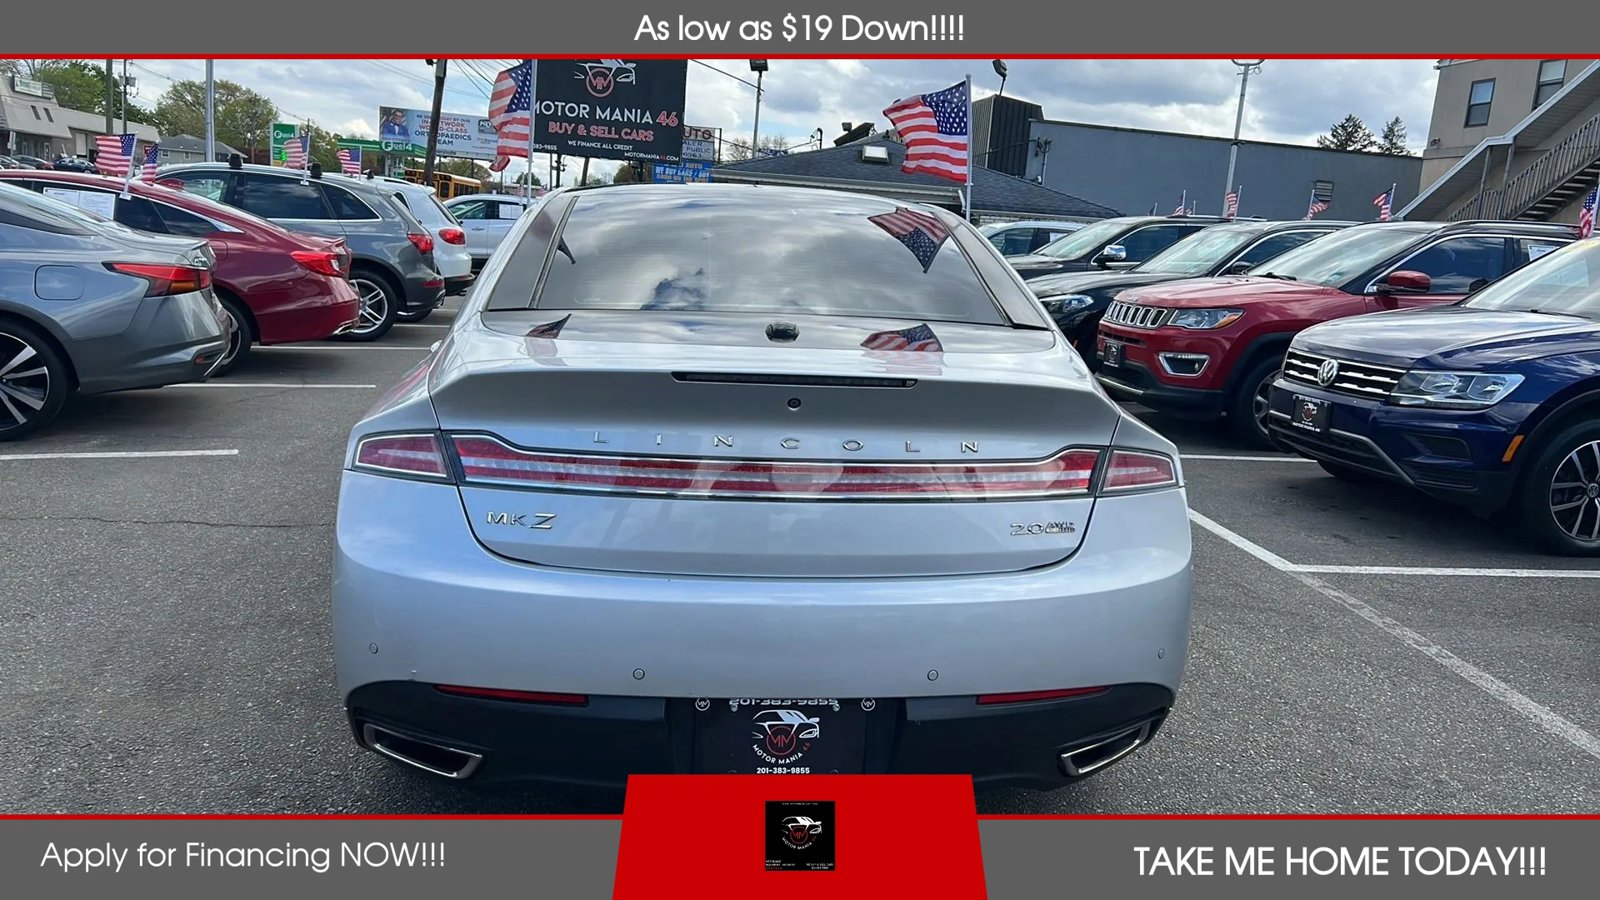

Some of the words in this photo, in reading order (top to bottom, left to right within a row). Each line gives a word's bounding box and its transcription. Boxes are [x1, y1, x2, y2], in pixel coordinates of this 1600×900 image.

[596, 105, 653, 124] MANIA
[656, 110, 679, 127] 46
[548, 121, 575, 136] BUY
[576, 123, 588, 136] &
[589, 124, 619, 139] SELL
[620, 128, 654, 142] CARS
[577, 141, 601, 149] FINANCE
[613, 144, 633, 152] CREDIT
[593, 431, 979, 453] LINCOLN
[752, 744, 776, 764] MOTOR
[778, 751, 804, 765] MANIA
[756, 767, 811, 775] 201-383-9855
